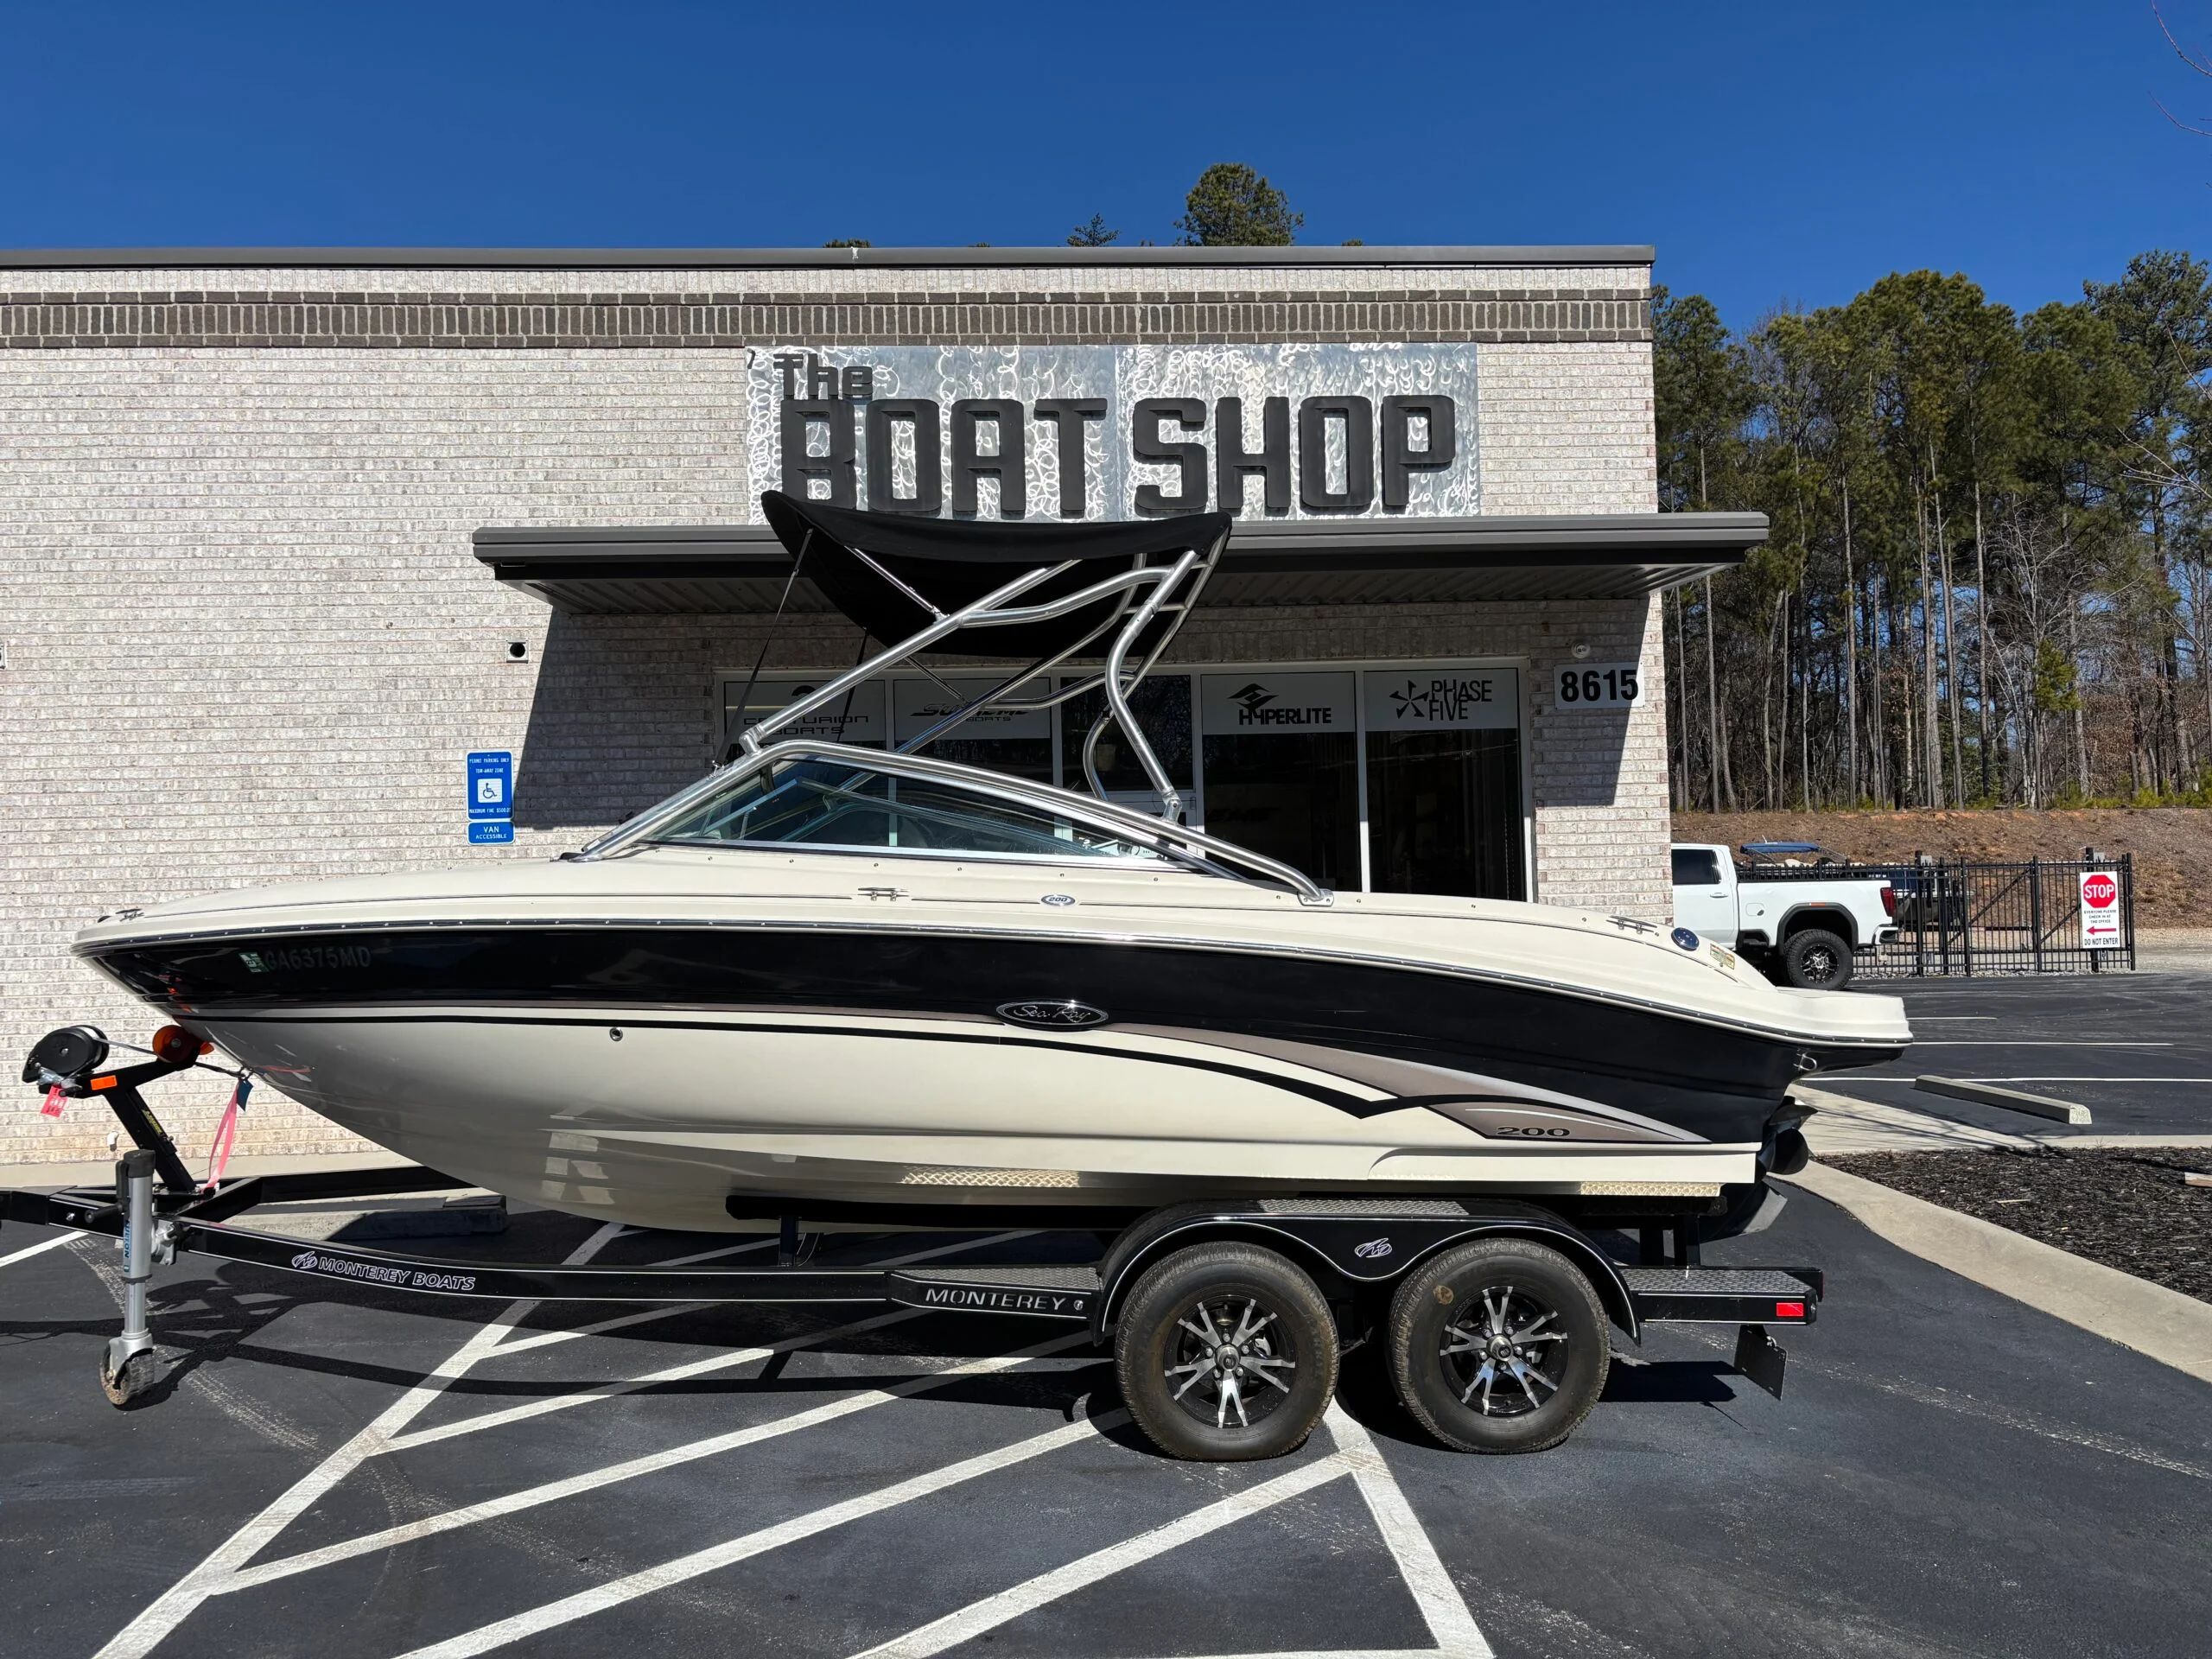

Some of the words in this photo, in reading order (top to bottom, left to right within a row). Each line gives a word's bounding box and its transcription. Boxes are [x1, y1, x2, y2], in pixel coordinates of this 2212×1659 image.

[772, 353, 873, 400] The
[780, 397, 1108, 515] BOAT
[1133, 394, 1455, 516] SHOP
[1430, 679, 1493, 704] PHASE
[1560, 668, 1639, 702] 8615
[1238, 707, 1332, 726] HYPERLITE
[1427, 695, 1469, 721] FIVE
[743, 715, 868, 725] CURION
[2084, 884, 2114, 899] STOP
[2102, 937, 2118, 945] ENTER
[1013, 1005, 1046, 1018] Sea
[1052, 1006, 1090, 1023] Ray
[1496, 1127, 1570, 1137] 200
[318, 1256, 411, 1284] MONTEREY
[412, 1272, 476, 1292] BOATS
[925, 1288, 1066, 1311] MONTEREY
